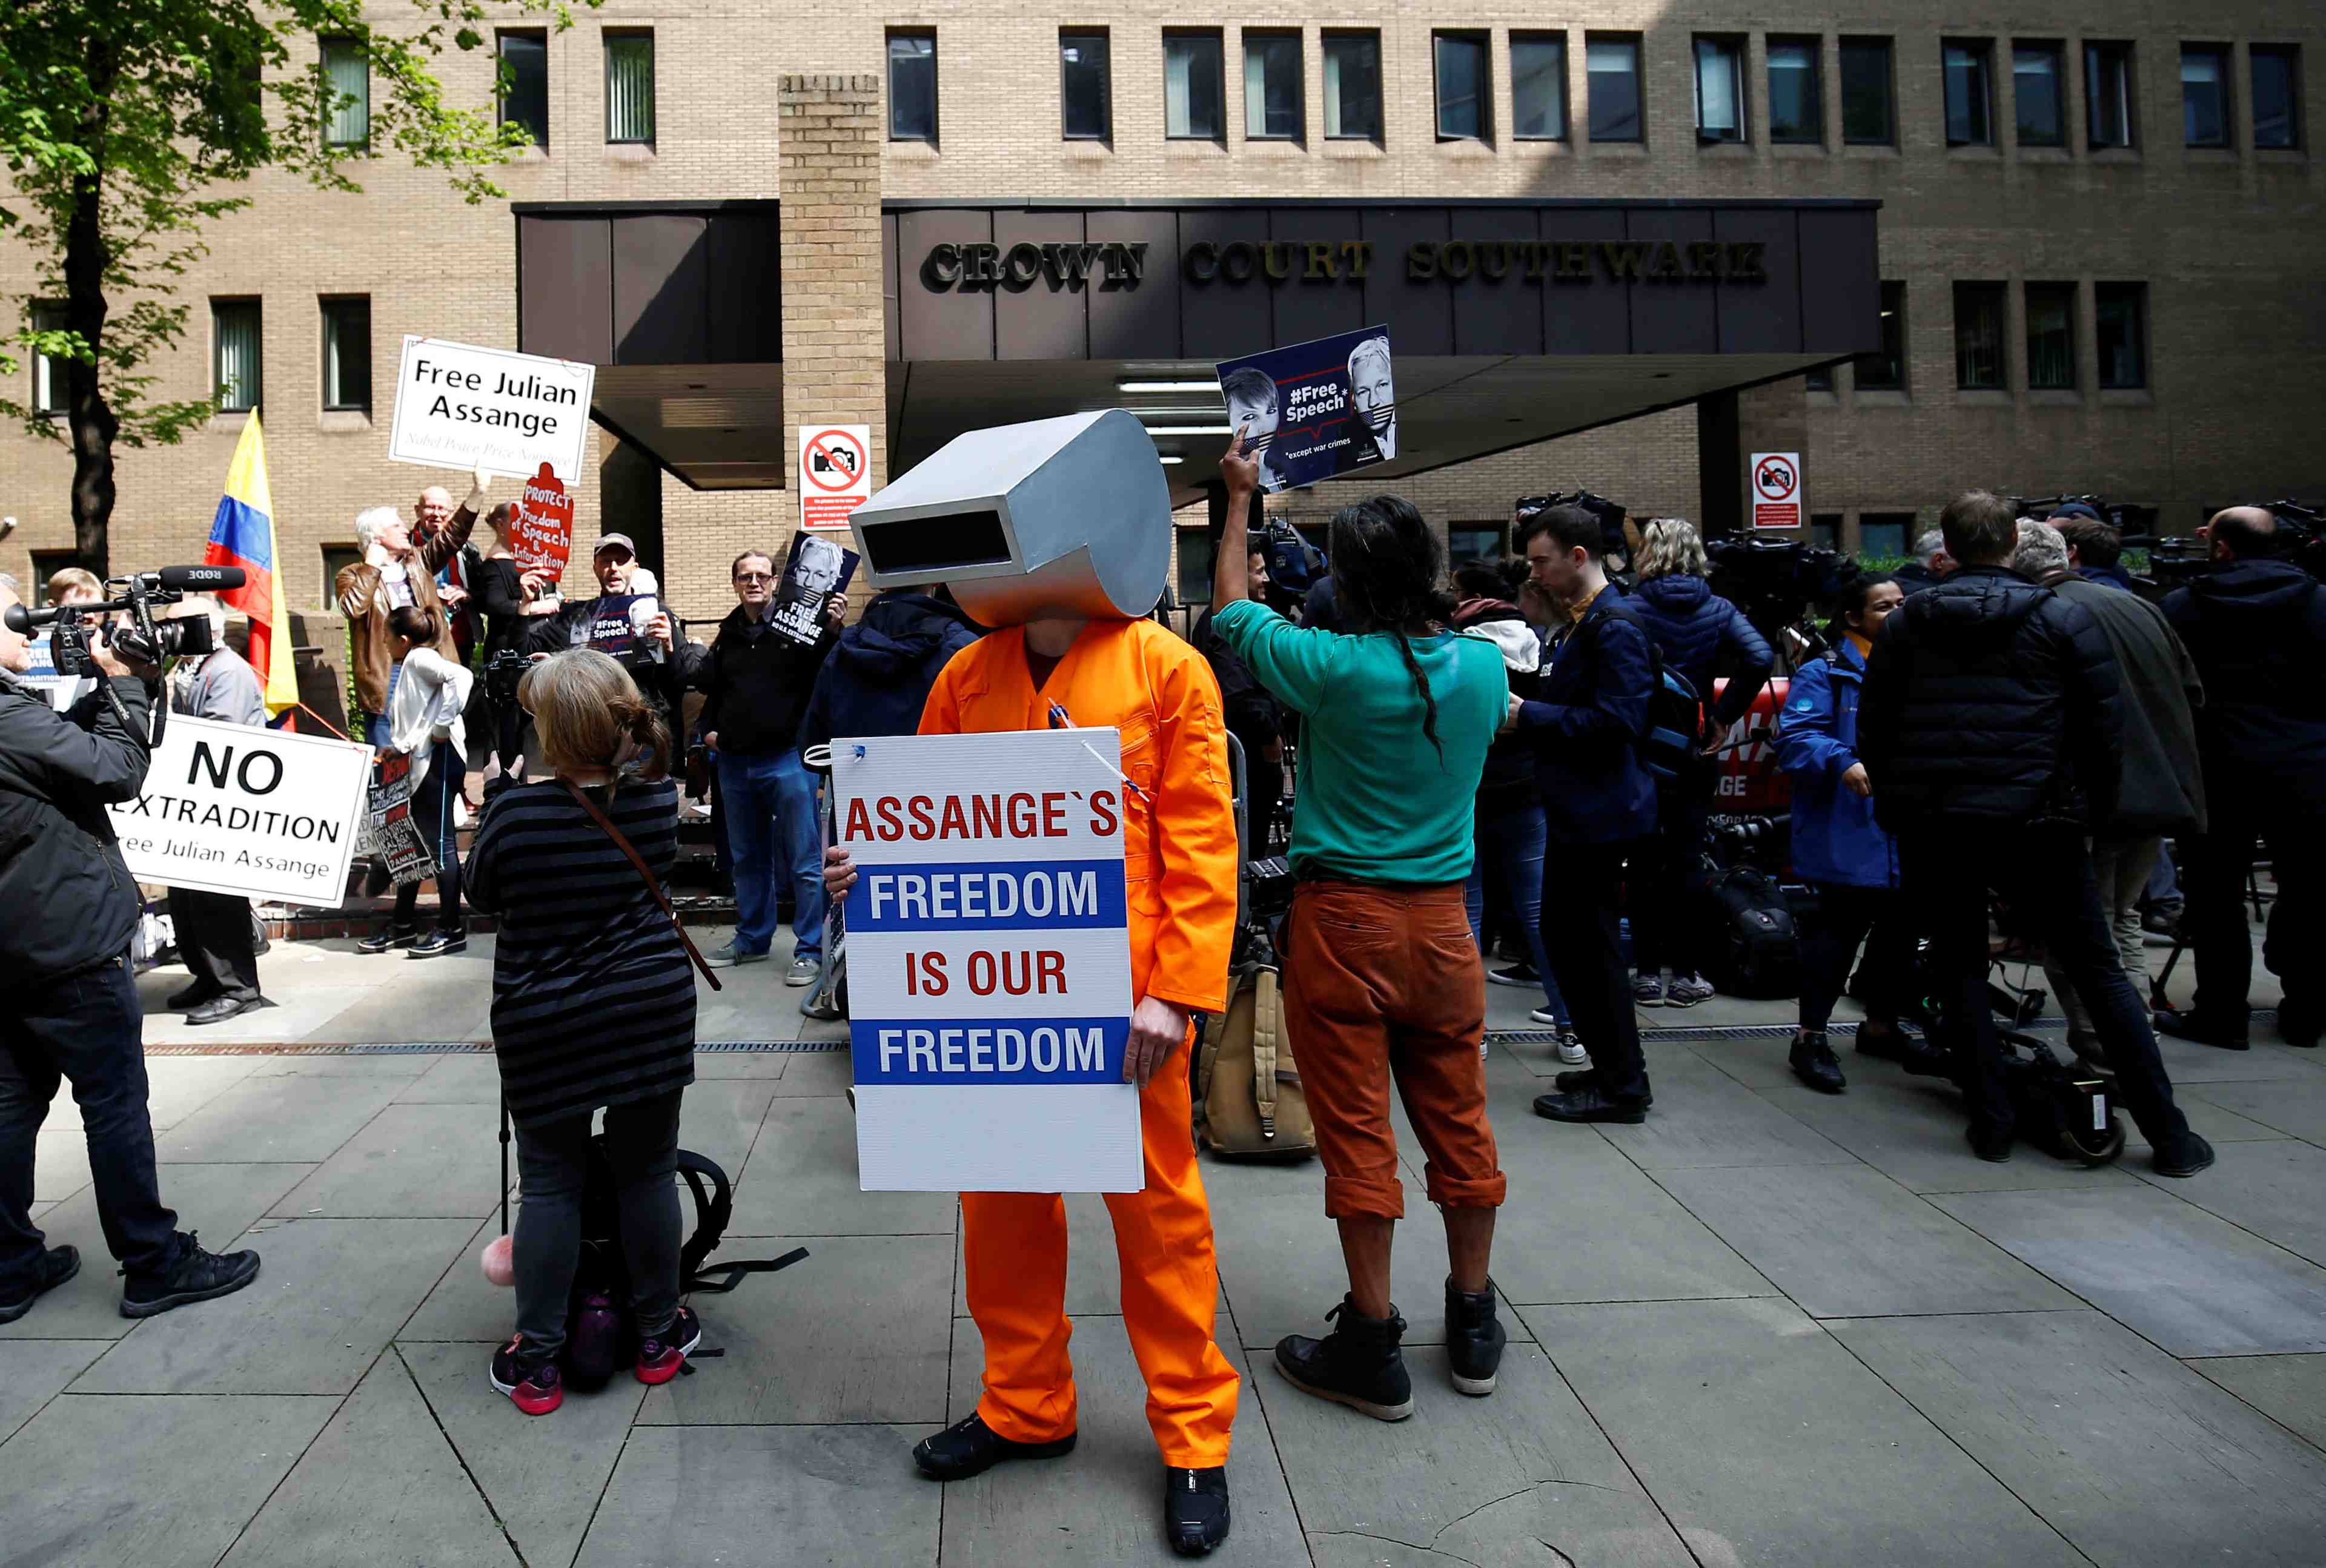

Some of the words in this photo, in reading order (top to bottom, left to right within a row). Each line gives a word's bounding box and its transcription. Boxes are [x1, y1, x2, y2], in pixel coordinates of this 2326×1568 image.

[929, 242, 1149, 282] CROWN
[1184, 240, 1375, 282] COURT
[1406, 240, 1766, 283] SOUTHWARK
[416, 359, 482, 391] Free
[493, 372, 577, 406] Julian
[1290, 383, 1337, 405] #Free
[429, 395, 558, 438] Assange
[1313, 443, 1327, 453] war
[1328, 437, 1351, 449] crimes
[525, 485, 571, 509] PROTECT
[511, 518, 522, 531] of
[522, 522, 569, 547] Speech
[520, 503, 560, 529] Freedom
[513, 543, 565, 569] Information
[532, 540, 540, 552] &
[774, 609, 823, 638] ASSANGE
[790, 601, 818, 623] FREE
[105, 683, 130, 720] Panasonic
[187, 740, 283, 795] NO
[162, 839, 225, 862] Julian
[235, 849, 330, 879] Assange
[869, 870, 1098, 919] FREEDOM
[906, 951, 949, 996] IS
[967, 950, 1068, 995] OUR
[878, 1027, 1105, 1072] FREEDOM
